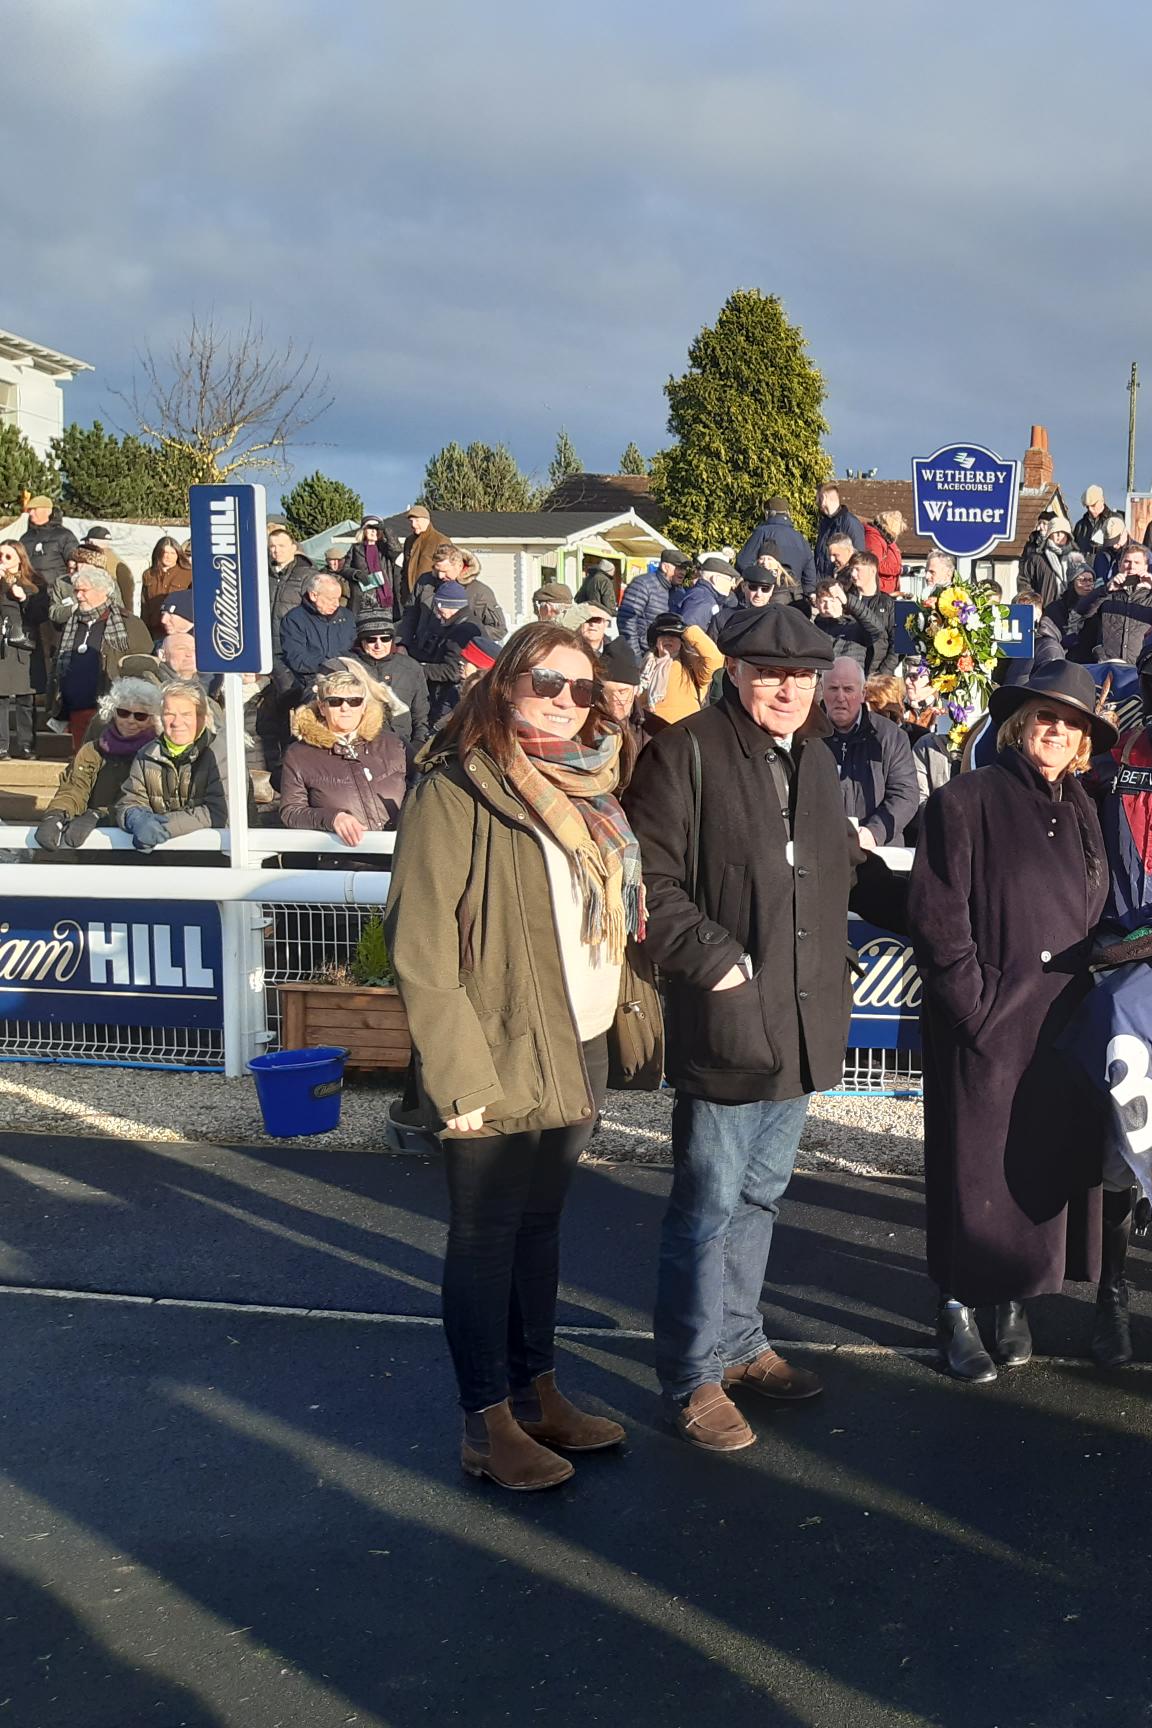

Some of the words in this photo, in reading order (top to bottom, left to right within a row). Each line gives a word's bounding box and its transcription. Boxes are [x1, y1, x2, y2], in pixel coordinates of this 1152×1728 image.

[921, 469, 1007, 484] WETHERBY
[937, 482, 993, 492] RACECOURSE
[210, 496, 236, 554] HILL
[923, 501, 1004, 523] Winner
[212, 555, 242, 661] William
[88, 922, 214, 988] HILL
